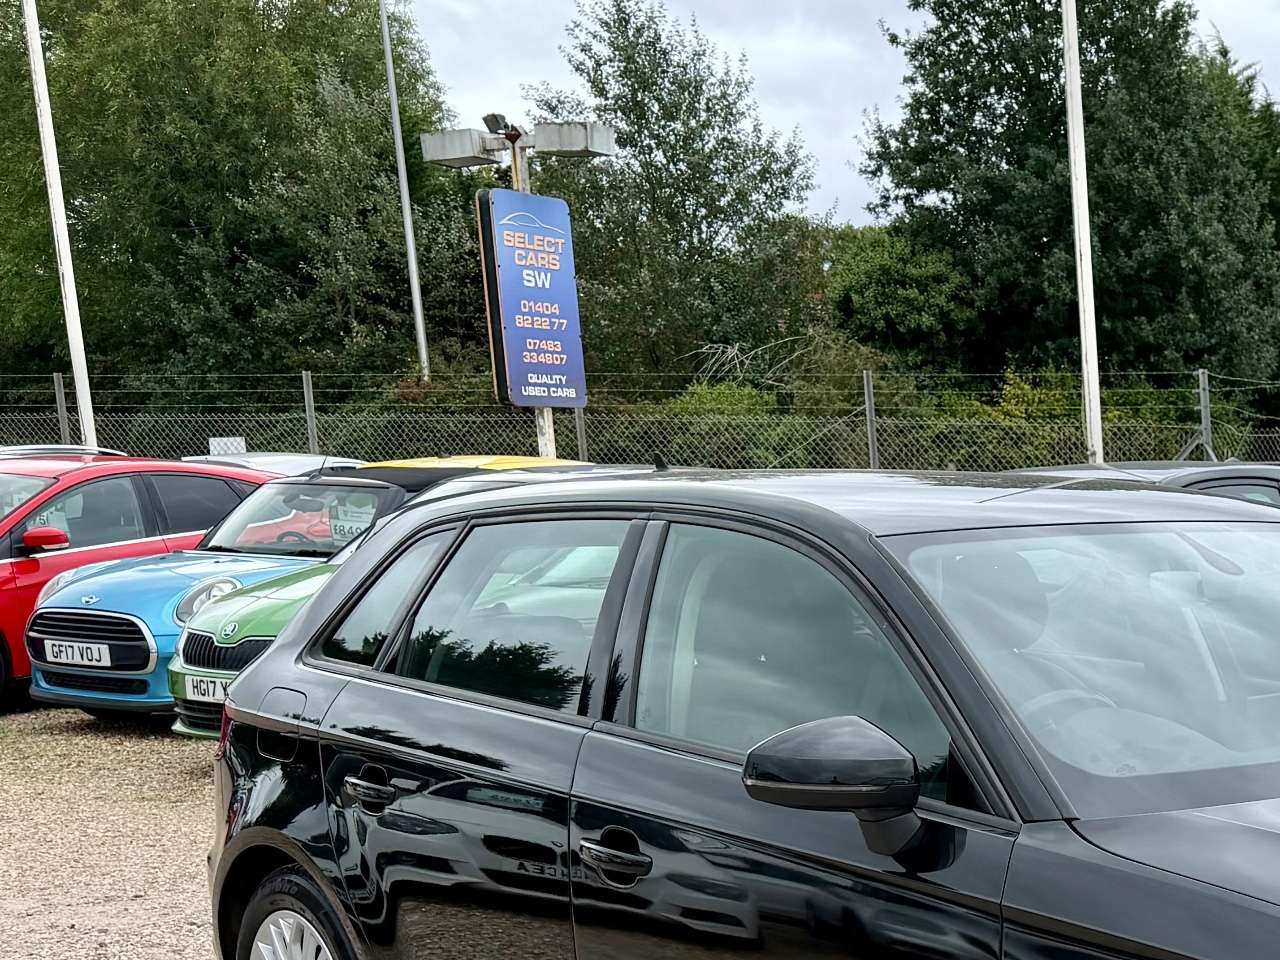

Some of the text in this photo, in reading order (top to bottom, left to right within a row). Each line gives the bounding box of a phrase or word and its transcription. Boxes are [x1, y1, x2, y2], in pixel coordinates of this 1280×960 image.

[503, 230, 565, 254] SELECT
[514, 249, 561, 270] CARS
[522, 269, 551, 289] SW
[520, 299, 560, 315] 01404
[527, 373, 567, 385] QUALITY
[521, 385, 577, 398] USED CARS
[51, 643, 102, 662] GF17 VOJ
[191, 678, 217, 698] HG17
